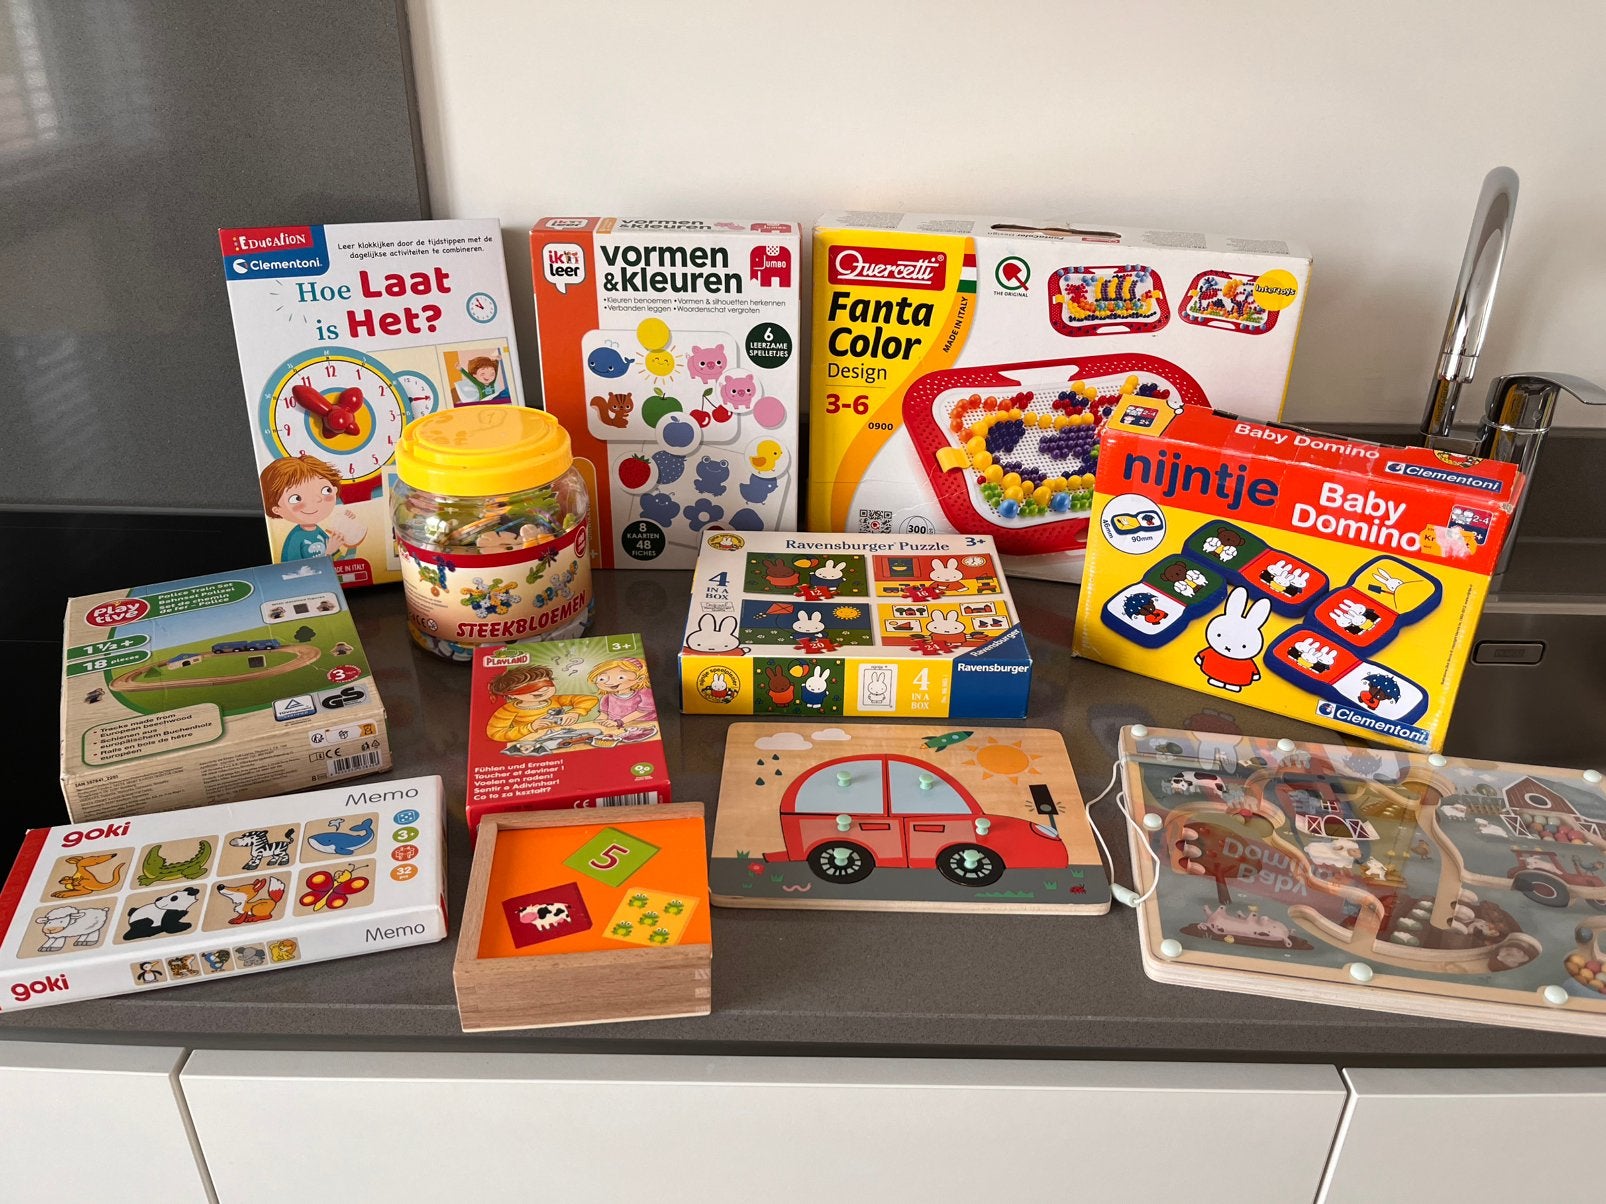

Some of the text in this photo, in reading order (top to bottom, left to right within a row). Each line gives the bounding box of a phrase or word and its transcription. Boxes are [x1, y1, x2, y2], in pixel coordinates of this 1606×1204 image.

[358, 241, 394, 250] klokkijken
[428, 238, 466, 246] tijdstippen
[350, 251, 387, 260] dagelijkse
[390, 249, 429, 258] activiteiten
[600, 245, 729, 268] vormen
[250, 257, 320, 271] Clementoni
[549, 264, 580, 276] leer
[836, 250, 940, 284] Quercetti
[295, 267, 452, 303] Hoe Laat
[604, 267, 742, 294] &kleuren
[1256, 284, 1296, 296] Intertoys
[647, 305, 672, 313] leggen
[828, 292, 934, 327] Fanta
[316, 304, 442, 341] is Het?
[943, 296, 968, 353] MADE IN ITALY
[764, 328, 774, 341] 6
[828, 326, 922, 360] Color
[325, 365, 336, 378] 12
[356, 368, 361, 380] 1
[828, 363, 887, 383] Design
[379, 386, 385, 396] 2
[284, 396, 296, 408] 10
[826, 393, 869, 415] 3-6
[389, 410, 396, 422] 3
[284, 424, 290, 436] 9
[868, 422, 894, 431] 0900
[388, 435, 394, 446] 4
[1234, 423, 1380, 459] Baby Domino
[372, 454, 378, 465] 5
[349, 463, 355, 474] 6
[1123, 450, 1278, 510] nijntje
[1406, 466, 1500, 490] Clementoni
[1319, 482, 1406, 525] Baby
[1473, 515, 1489, 524] 2-4
[640, 523, 646, 532] 8
[908, 525, 926, 534] 300
[1291, 503, 1420, 552] Domino
[636, 540, 651, 550] 48
[786, 540, 950, 552] Ravensburger Puzzle
[966, 537, 986, 547] 3+
[709, 572, 730, 587] 4
[158, 591, 188, 599] Police
[456, 590, 586, 638] STEEKBLOEMEN
[612, 642, 631, 651] 3+
[970, 628, 1020, 657] Ravensburger
[83, 660, 108, 671] 18
[958, 663, 1029, 675] Ravensburger
[332, 669, 346, 680] 3
[913, 668, 930, 690] 4
[100, 715, 192, 738] European beechwood
[100, 724, 128, 732] Tracks
[163, 722, 212, 736] Buchenholz
[1336, 708, 1426, 743] Clementoni
[100, 733, 140, 744] Schienen
[345, 785, 419, 808] Memo
[61, 821, 130, 848] goki
[398, 830, 415, 840] 3+
[589, 844, 630, 870] 5
[397, 866, 412, 875] 32
[364, 921, 426, 943] Memo
[10, 974, 70, 1002] goki
